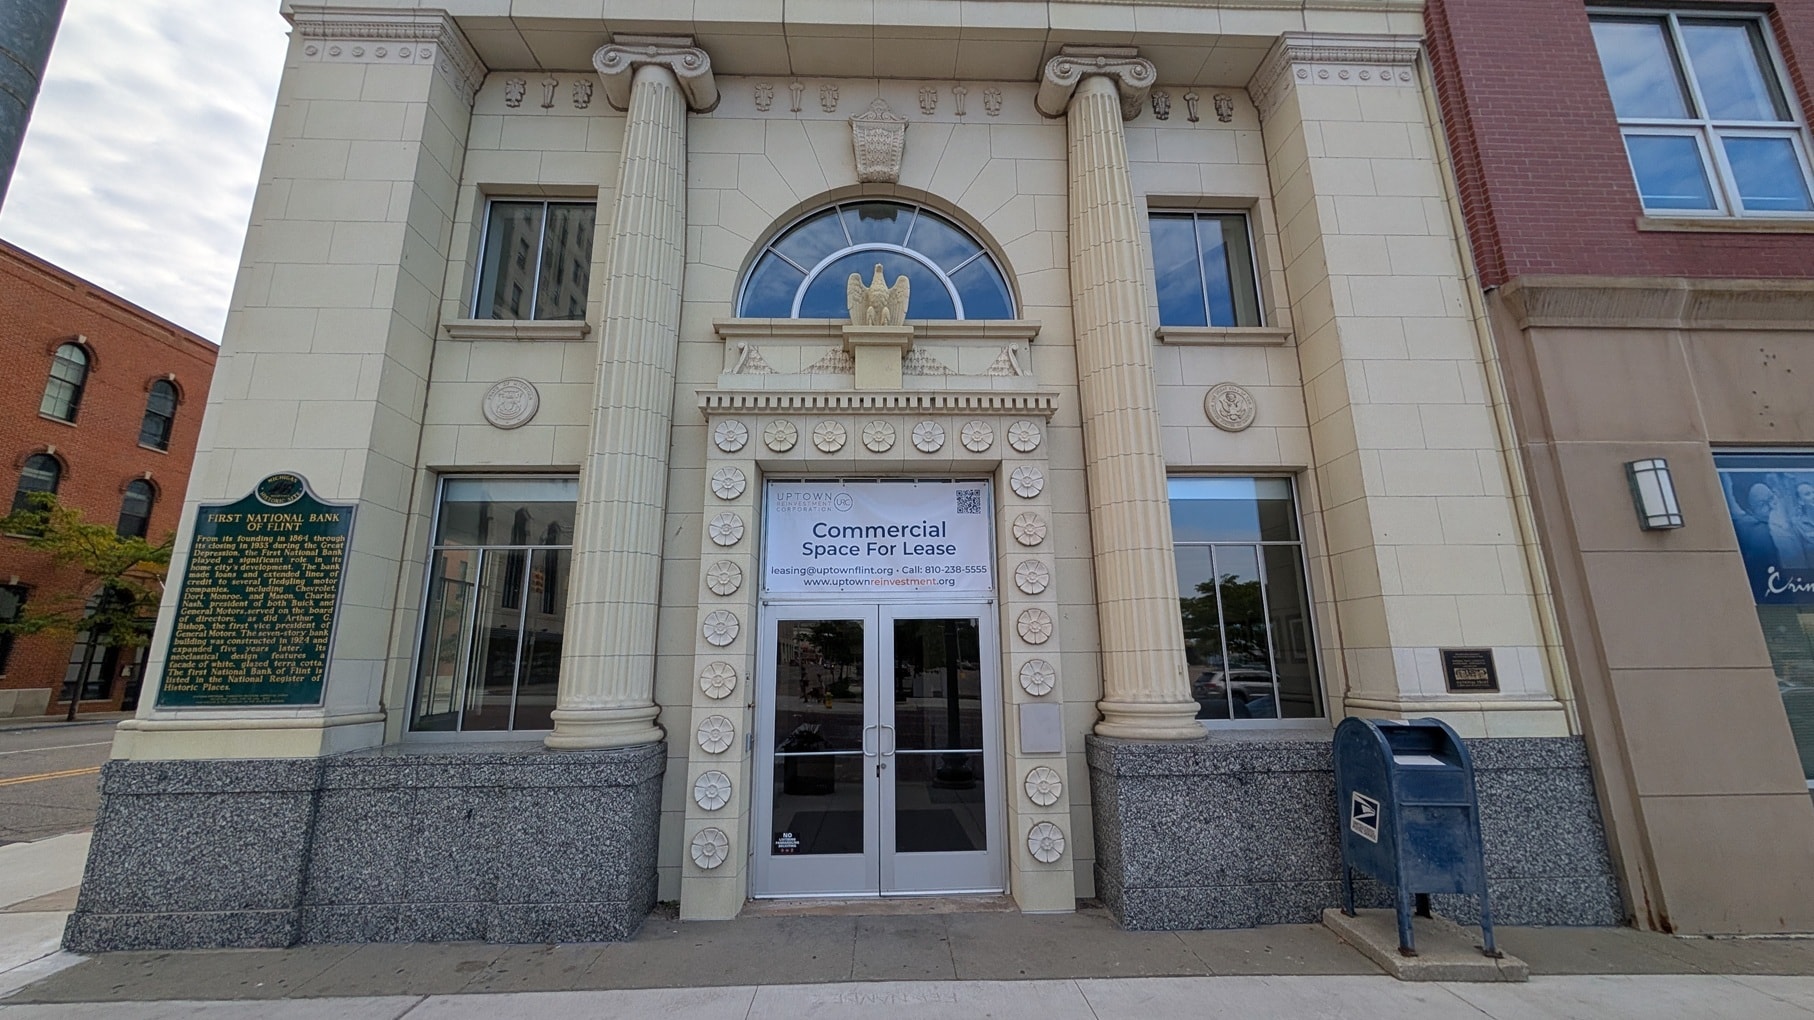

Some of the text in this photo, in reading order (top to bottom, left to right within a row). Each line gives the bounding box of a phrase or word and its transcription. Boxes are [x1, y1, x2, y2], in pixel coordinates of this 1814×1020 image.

[267, 475, 298, 483] MICHIGAN
[260, 491, 286, 504] HISTORIC
[777, 492, 832, 501] UPTOWN
[836, 498, 851, 507] URC
[208, 513, 339, 522] FIRST NATIONAL BANK
[247, 521, 302, 531] OF FLINT
[812, 520, 946, 538] Commercial
[237, 535, 274, 543] founding
[313, 535, 346, 543] through
[208, 542, 236, 550] closing
[272, 542, 300, 550] during
[320, 541, 344, 550] Great
[802, 541, 956, 559] Space For Lease
[261, 548, 281, 556] First
[284, 548, 319, 556] National
[322, 548, 342, 556] Bank
[191, 556, 222, 565] played
[239, 556, 283, 564] significant
[290, 556, 307, 564] role
[331, 556, 342, 564] its
[190, 563, 211, 572] home
[302, 562, 317, 570] The
[771, 565, 987, 577] leasing@uptownflint.org Call: 810-238-5555
[188, 570, 210, 579] made
[215, 570, 237, 578] loans
[243, 570, 258, 578] and
[263, 570, 300, 578] extended
[187, 577, 212, 586] credit
[268, 577, 306, 586] fledgling
[803, 578, 955, 587] www.uptownreinvestment.org
[245, 585, 284, 593] including
[248, 592, 265, 600] and
[304, 591, 336, 600] Charles
[209, 599, 248, 608] president
[253, 599, 263, 607] of
[267, 599, 287, 607] both
[291, 599, 314, 608] Buick
[319, 599, 335, 607] and
[181, 607, 213, 615] General
[292, 606, 304, 614] the
[309, 606, 334, 614] board
[178, 614, 190, 623] of
[263, 614, 278, 622] did
[284, 614, 314, 622] Arthur
[212, 622, 226, 630] the
[229, 622, 249, 630] first
[275, 621, 315, 630] president
[320, 621, 331, 629] of
[176, 629, 207, 638] General
[241, 629, 257, 637] The
[258, 629, 306, 637] seven-story
[174, 637, 207, 645] building
[312, 636, 328, 644] and
[172, 644, 213, 653] expanded
[220, 644, 237, 653] five
[315, 644, 326, 652] Its
[170, 652, 219, 661] neoclassical
[230, 652, 258, 660] design
[271, 652, 306, 660] features
[198, 660, 209, 668] of
[241, 660, 269, 668] glazed
[274, 660, 296, 668] terra
[168, 668, 184, 676] The
[187, 668, 207, 676] first
[211, 668, 246, 676] National
[250, 667, 272, 675] Bank
[275, 667, 286, 675] of
[165, 675, 190, 684] listed
[208, 675, 222, 684] the
[228, 675, 264, 683] National
[269, 675, 305, 683] Register
[311, 674, 321, 682] of
[164, 683, 198, 691] Historic
